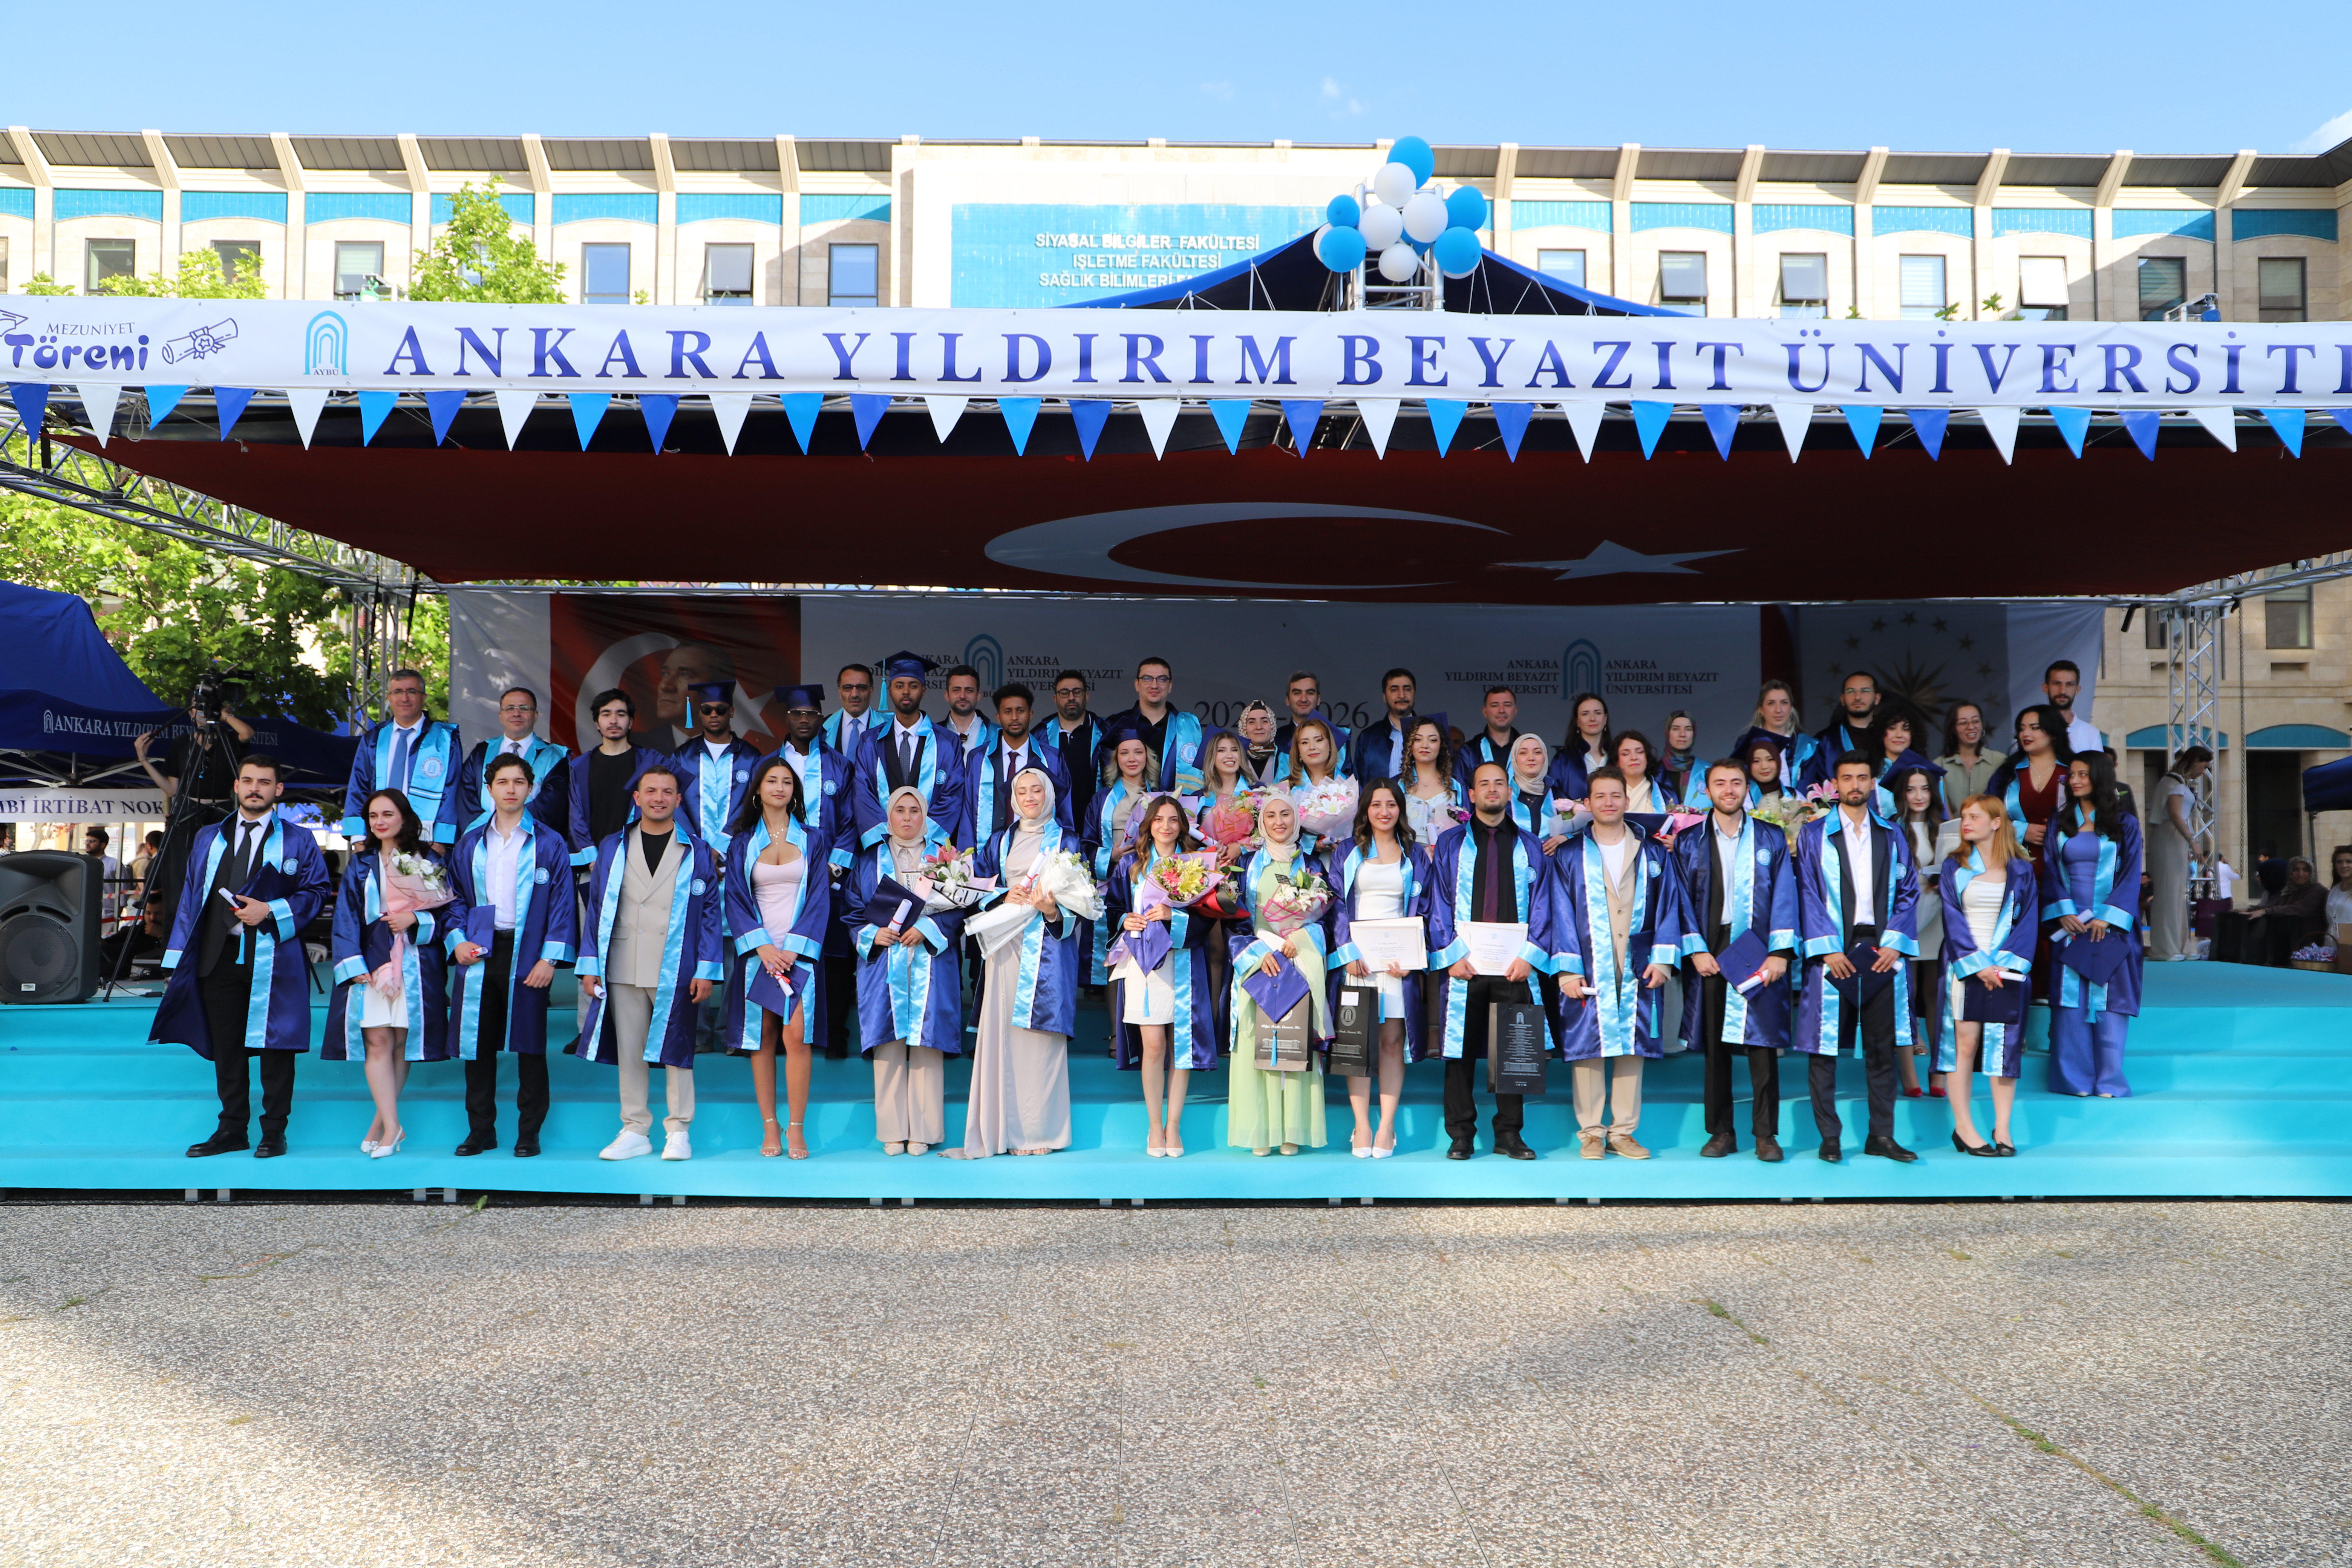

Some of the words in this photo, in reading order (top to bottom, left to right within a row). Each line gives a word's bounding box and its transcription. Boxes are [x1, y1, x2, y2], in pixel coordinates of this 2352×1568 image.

[1035, 231, 1098, 248] SİYASAL
[1102, 232, 1171, 249] BİLGİLER
[1179, 234, 1259, 250] FAKÜLTESİ
[1141, 252, 1222, 269] FAKÜLTESİ
[1039, 270, 1095, 287] SAĞLIK
[46, 322, 135, 335] MEZUNİYET
[4, 334, 149, 371] Töreni
[383, 325, 785, 379] ANKARA
[822, 332, 1297, 385] YILDIRIM
[1337, 335, 1744, 390] BEYAZIT
[1007, 656, 1060, 665] ANKARA
[1507, 660, 1559, 669] ANKARA
[1605, 660, 1657, 669] ANKARA
[1079, 669, 1123, 678] EYAZIT
[1444, 672, 1504, 681] YILDIRIM
[1507, 672, 1559, 682] BEYAZIT
[1605, 672, 1664, 682] YILDIRIM
[1668, 672, 1720, 682] BEYAZIT
[1605, 683, 1693, 694] ÜNİVERSİTESİ
[1194, 701, 1247, 728] 202
[1317, 701, 1370, 729] 026
[55, 715, 112, 736] ANKARA
[32, 795, 115, 814] İRTİBAT
